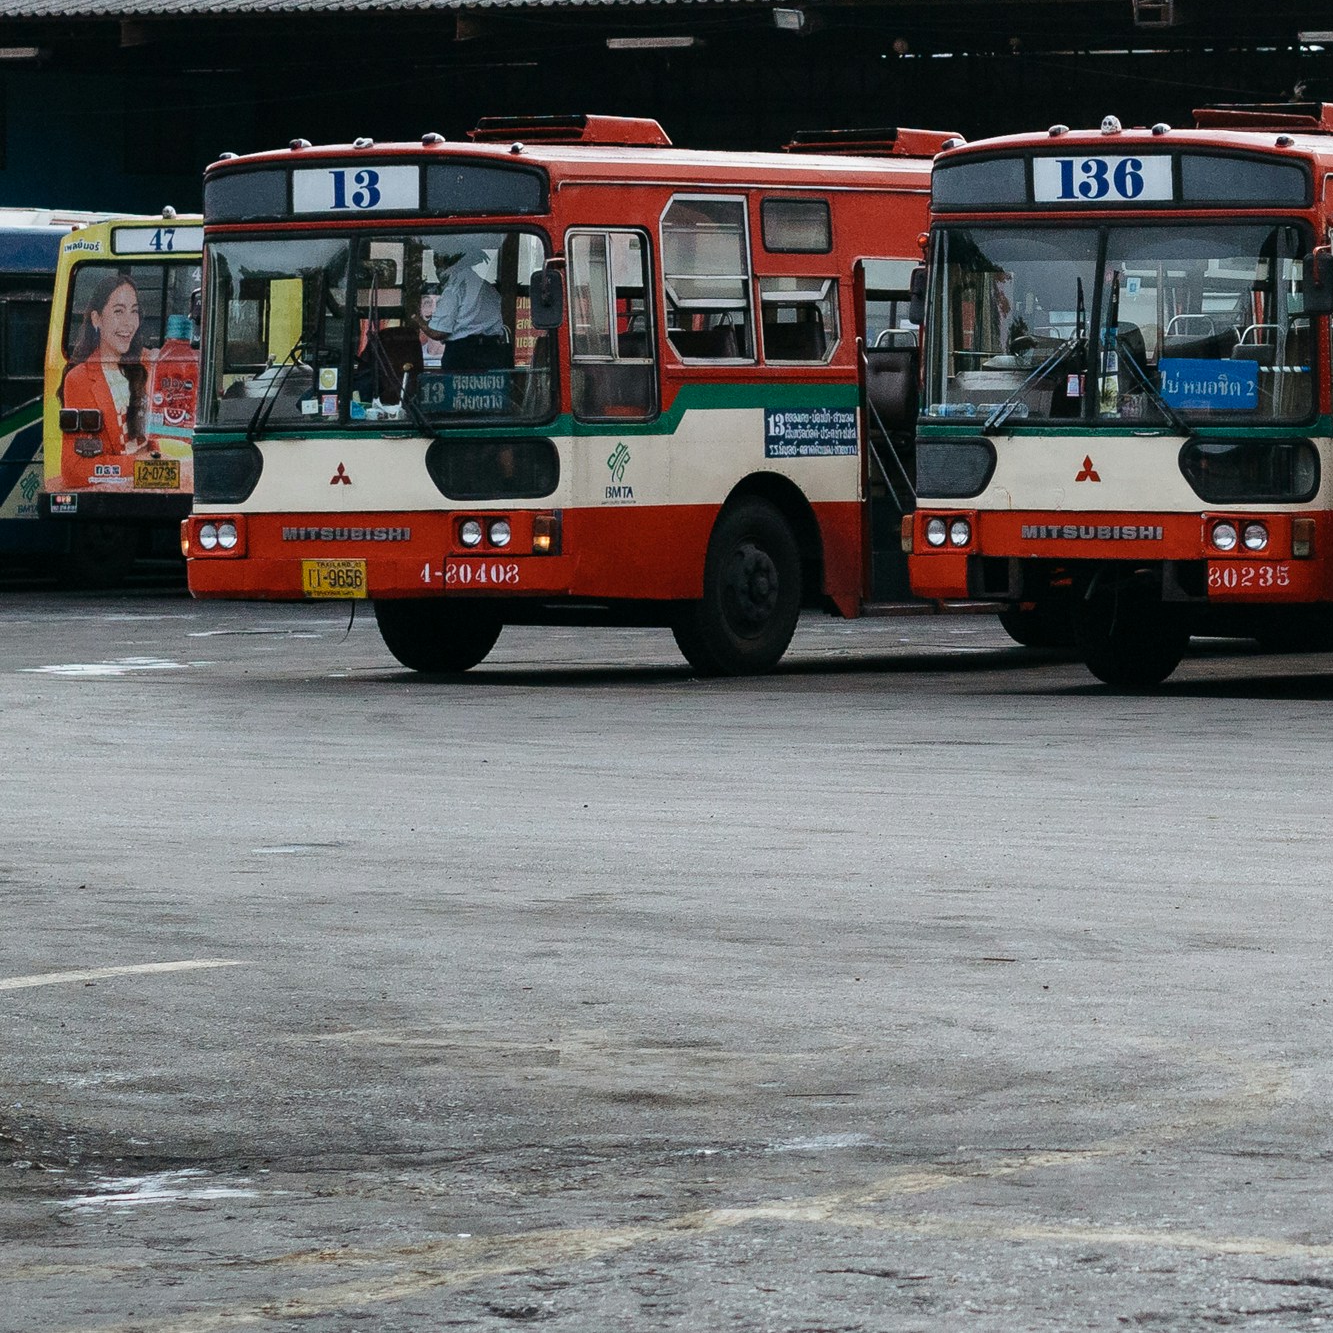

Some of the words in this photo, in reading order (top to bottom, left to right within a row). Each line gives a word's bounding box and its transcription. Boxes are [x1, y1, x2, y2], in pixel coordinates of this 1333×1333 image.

[329, 169, 381, 209] 13
[1055, 158, 1144, 199] 136
[149, 228, 175, 251] 47
[420, 381, 445, 404] 13
[1246, 380, 1255, 396] 2
[767, 413, 785, 436] 13
[605, 486, 634, 499] BMTA
[282, 527, 411, 542] MITSUBISHI
[1021, 525, 1163, 540] MITSUBISHI
[420, 563, 520, 584] 4-80408
[1208, 566, 1290, 588] 80235
